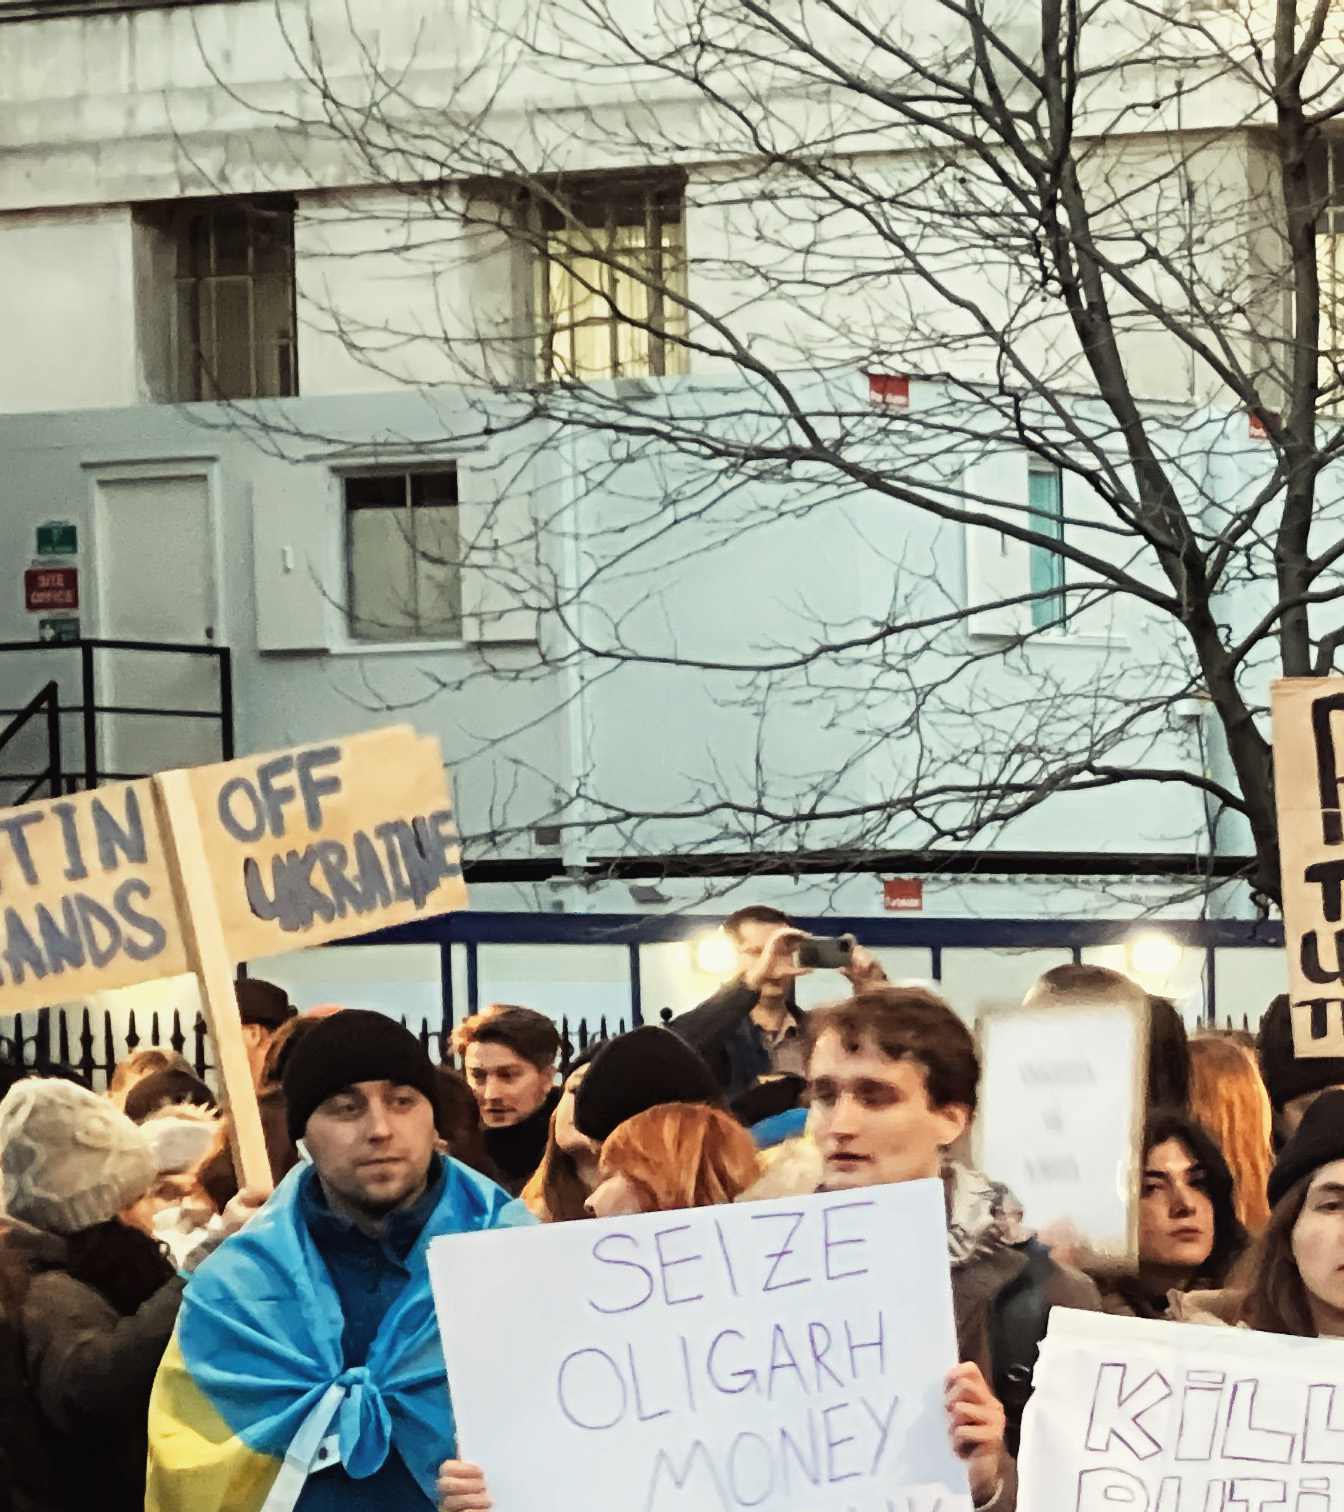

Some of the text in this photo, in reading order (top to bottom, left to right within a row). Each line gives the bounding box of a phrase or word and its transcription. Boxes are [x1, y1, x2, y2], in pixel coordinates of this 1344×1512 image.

[0, 786, 149, 887] TIN
[217, 745, 342, 843] OFF
[243, 808, 461, 932] UKRAINE
[0, 877, 168, 987] ANDS
[588, 1201, 876, 1315] SEIZE
[557, 1310, 887, 1431] OLIGARH
